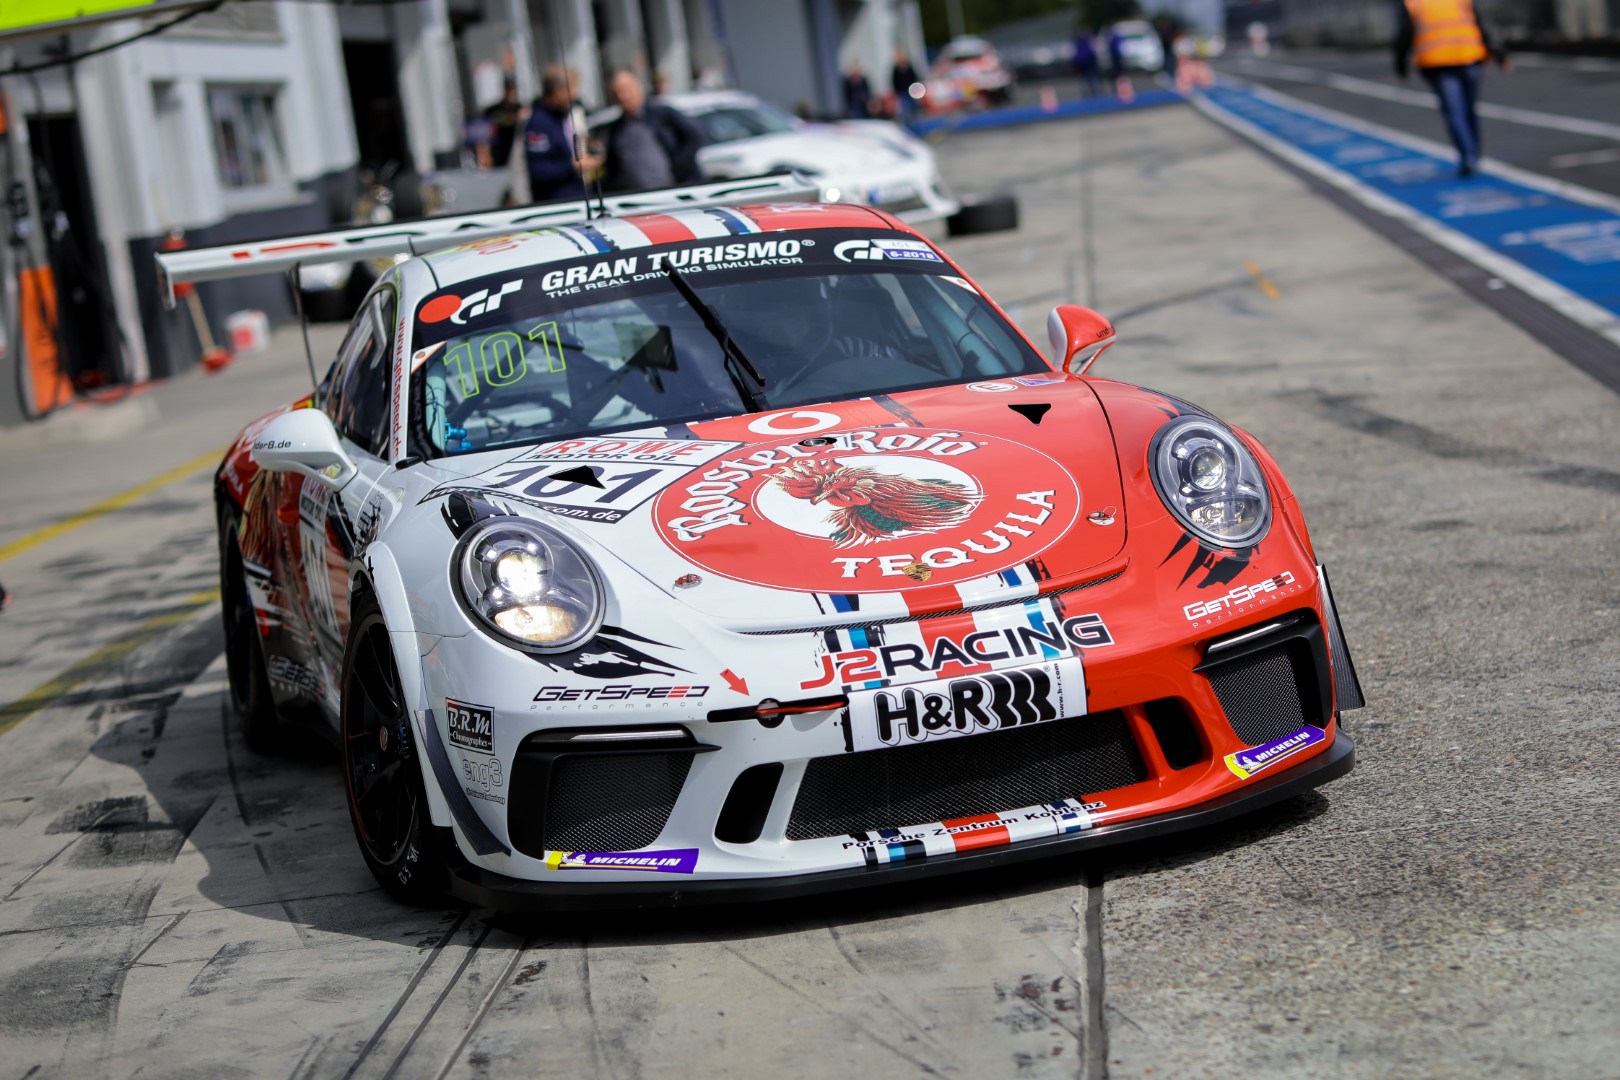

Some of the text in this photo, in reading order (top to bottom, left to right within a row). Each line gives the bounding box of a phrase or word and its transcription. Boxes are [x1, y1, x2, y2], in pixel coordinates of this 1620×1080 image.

[541, 257, 637, 292] GRAN
[546, 257, 803, 299] THE REAL DRIVNG SIMULATOR
[443, 321, 567, 399] 101
[544, 441, 715, 456] ROWE
[480, 464, 664, 504] 101
[667, 443, 818, 542] Rooster
[831, 489, 1057, 578] TEQUILA
[800, 613, 1115, 690] J2RACING
[1256, 731, 1311, 763] MICHELIN
[463, 758, 503, 792] eng3
[841, 799, 1107, 850] Porsche Zentrum Koblenz
[591, 856, 682, 867] MICHELIN
